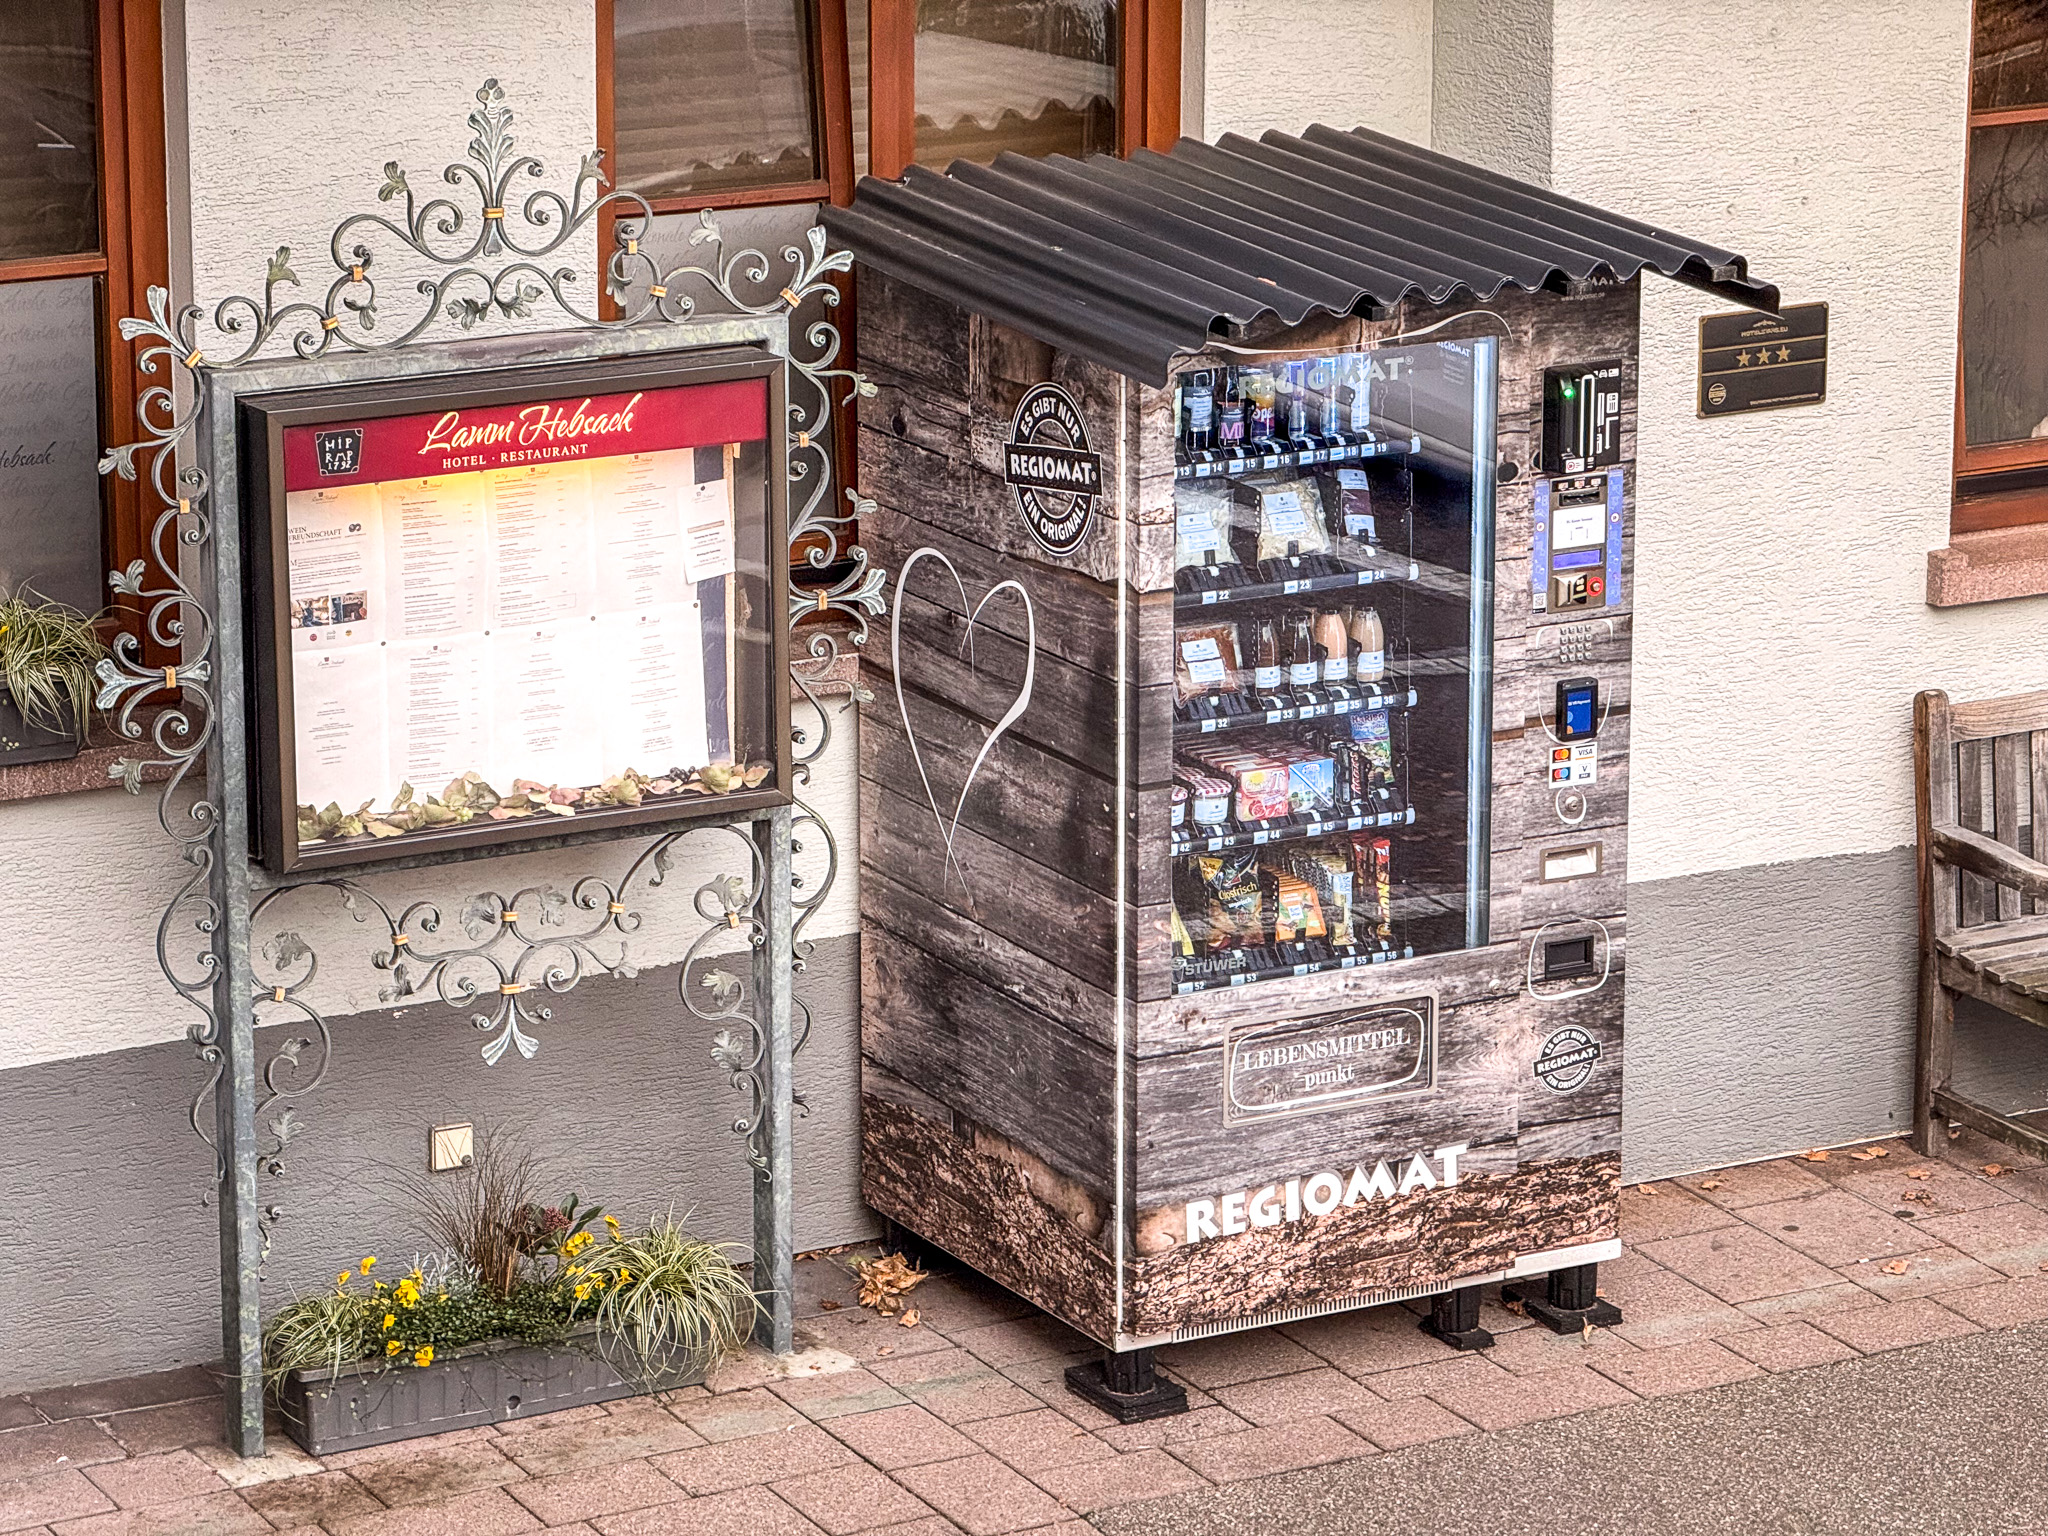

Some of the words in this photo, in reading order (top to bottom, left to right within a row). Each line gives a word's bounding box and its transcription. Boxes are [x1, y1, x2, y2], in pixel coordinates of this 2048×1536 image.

[418, 411, 514, 454] Lamm
[518, 393, 643, 445] Hebsack
[1020, 412, 1034, 437] ES
[1032, 397, 1057, 419] GIBT
[1057, 401, 1081, 443] NUR
[442, 454, 487, 468] HOTEL
[500, 443, 588, 463] RESTAURANT
[1179, 467, 1190, 476] 13
[1212, 463, 1222, 473] 14
[1246, 459, 1256, 468] 15
[1280, 455, 1290, 464] 16
[1315, 450, 1325, 460] 17
[1346, 446, 1356, 456] 18
[1376, 442, 1387, 452] 19
[288, 526, 307, 534] WEIN
[1022, 490, 1041, 525] EIN
[1040, 496, 1087, 541] ORIGINAL!
[288, 528, 342, 541] FREUNDSCHAFT
[1218, 590, 1230, 600] 22
[1299, 579, 1310, 589] 23
[1374, 570, 1384, 580] 24
[1217, 718, 1228, 729] 32
[1282, 709, 1293, 719] 33
[1315, 705, 1326, 715] 34
[1349, 699, 1360, 709] 35
[1351, 712, 1386, 723] HARIBO
[1577, 748, 1593, 756] VISA
[1179, 843, 1190, 852] 42
[1224, 836, 1234, 846] 43
[1269, 830, 1280, 840] 44
[1323, 822, 1333, 831] 45
[1363, 816, 1373, 825] 46
[1392, 813, 1403, 822] 47
[1185, 956, 1247, 976] STÜWER
[1194, 982, 1205, 991] 52
[1246, 974, 1257, 983] 53
[1309, 963, 1319, 973] 54
[1357, 956, 1367, 966] 55
[1387, 951, 1397, 960] 56
[1242, 1027, 1411, 1071] LEBENSMITTEL
[1304, 1064, 1355, 1091] punkt
[1185, 1143, 1469, 1244] REGIOMAT
